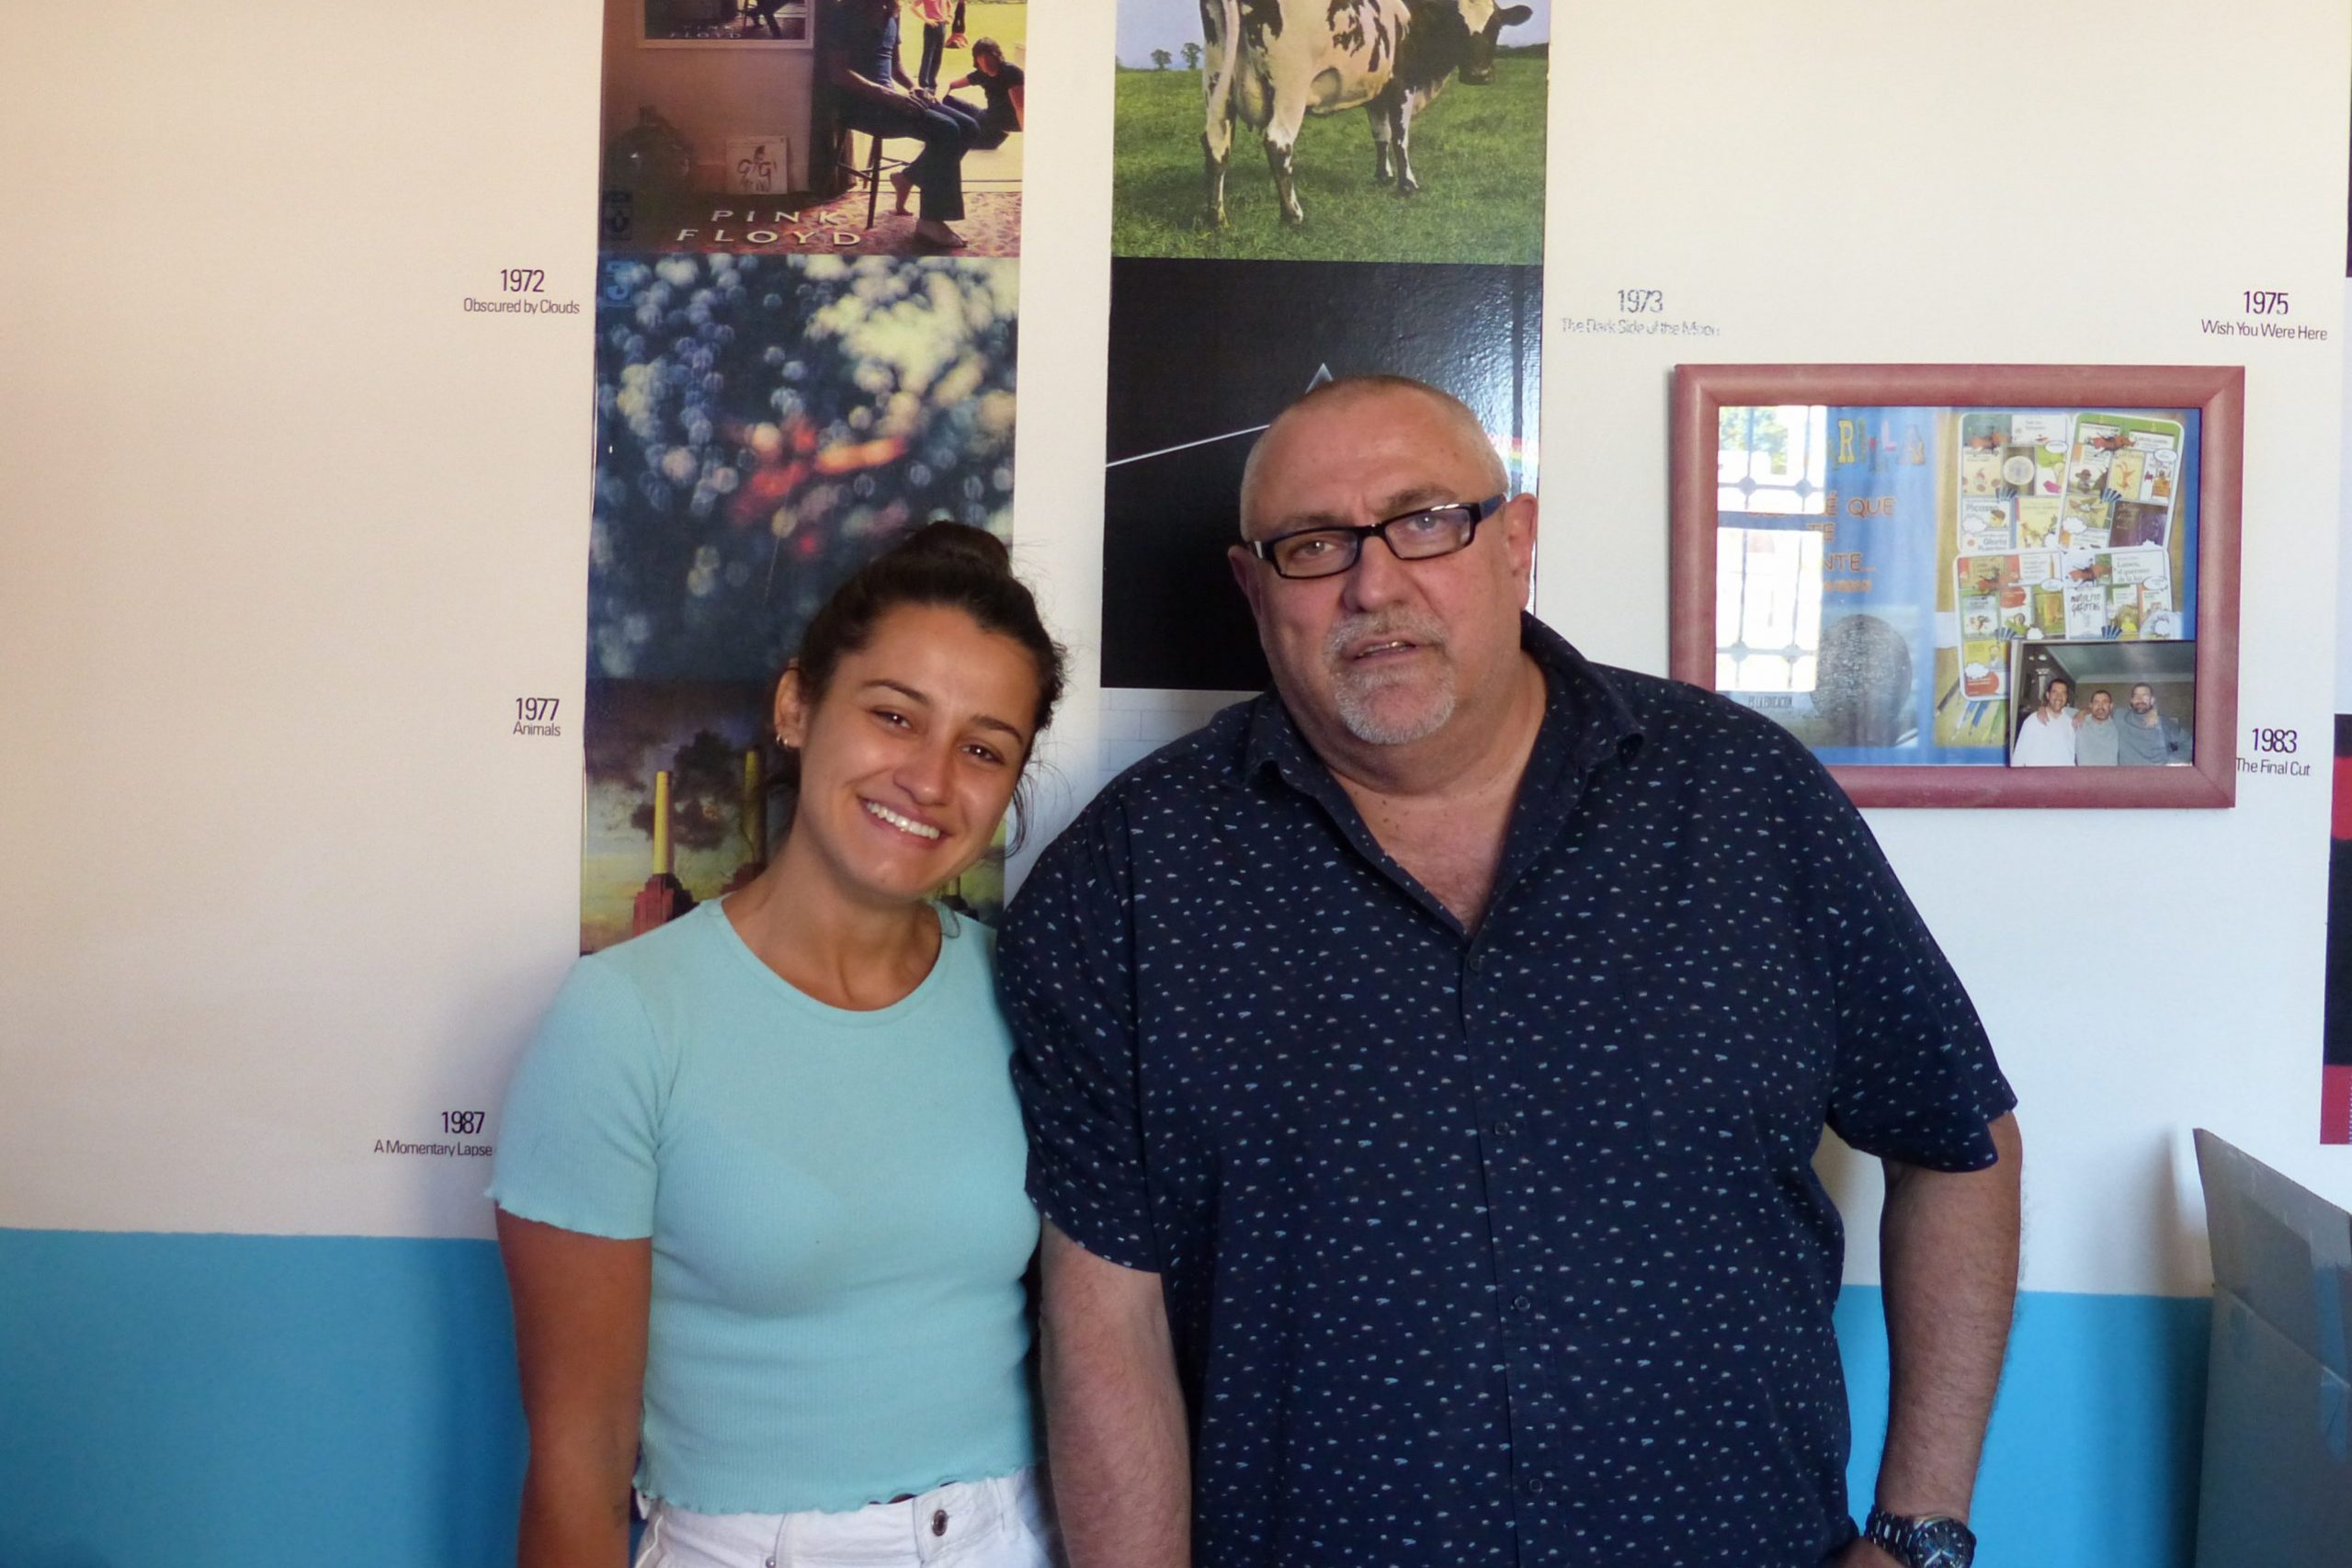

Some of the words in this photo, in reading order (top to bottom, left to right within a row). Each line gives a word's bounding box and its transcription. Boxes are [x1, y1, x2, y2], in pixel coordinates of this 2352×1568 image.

[710, 210, 840, 225] PINK
[676, 229, 861, 246] FLOYD
[501, 269, 545, 292] 1972
[463, 297, 521, 313] Obscured
[524, 300, 538, 314] by
[540, 299, 580, 314] Clouds
[1618, 290, 1663, 312] 1973
[2244, 290, 2289, 314] 1975
[2201, 319, 2234, 335] Wish
[2236, 322, 2258, 336] You
[2261, 324, 2295, 339] Were
[2298, 325, 2328, 340] Here
[1847, 497, 1895, 518] QUE
[516, 698, 560, 721] 1977
[513, 721, 561, 736] Animals
[2252, 728, 2298, 754] 1983
[2236, 757, 2258, 773] The
[2261, 759, 2288, 775] Final
[2290, 761, 2311, 777] Cut
[441, 1110, 485, 1134] 1987
[374, 1140, 384, 1153] A
[386, 1140, 456, 1157] Momentary
[458, 1142, 493, 1157] Lapse
